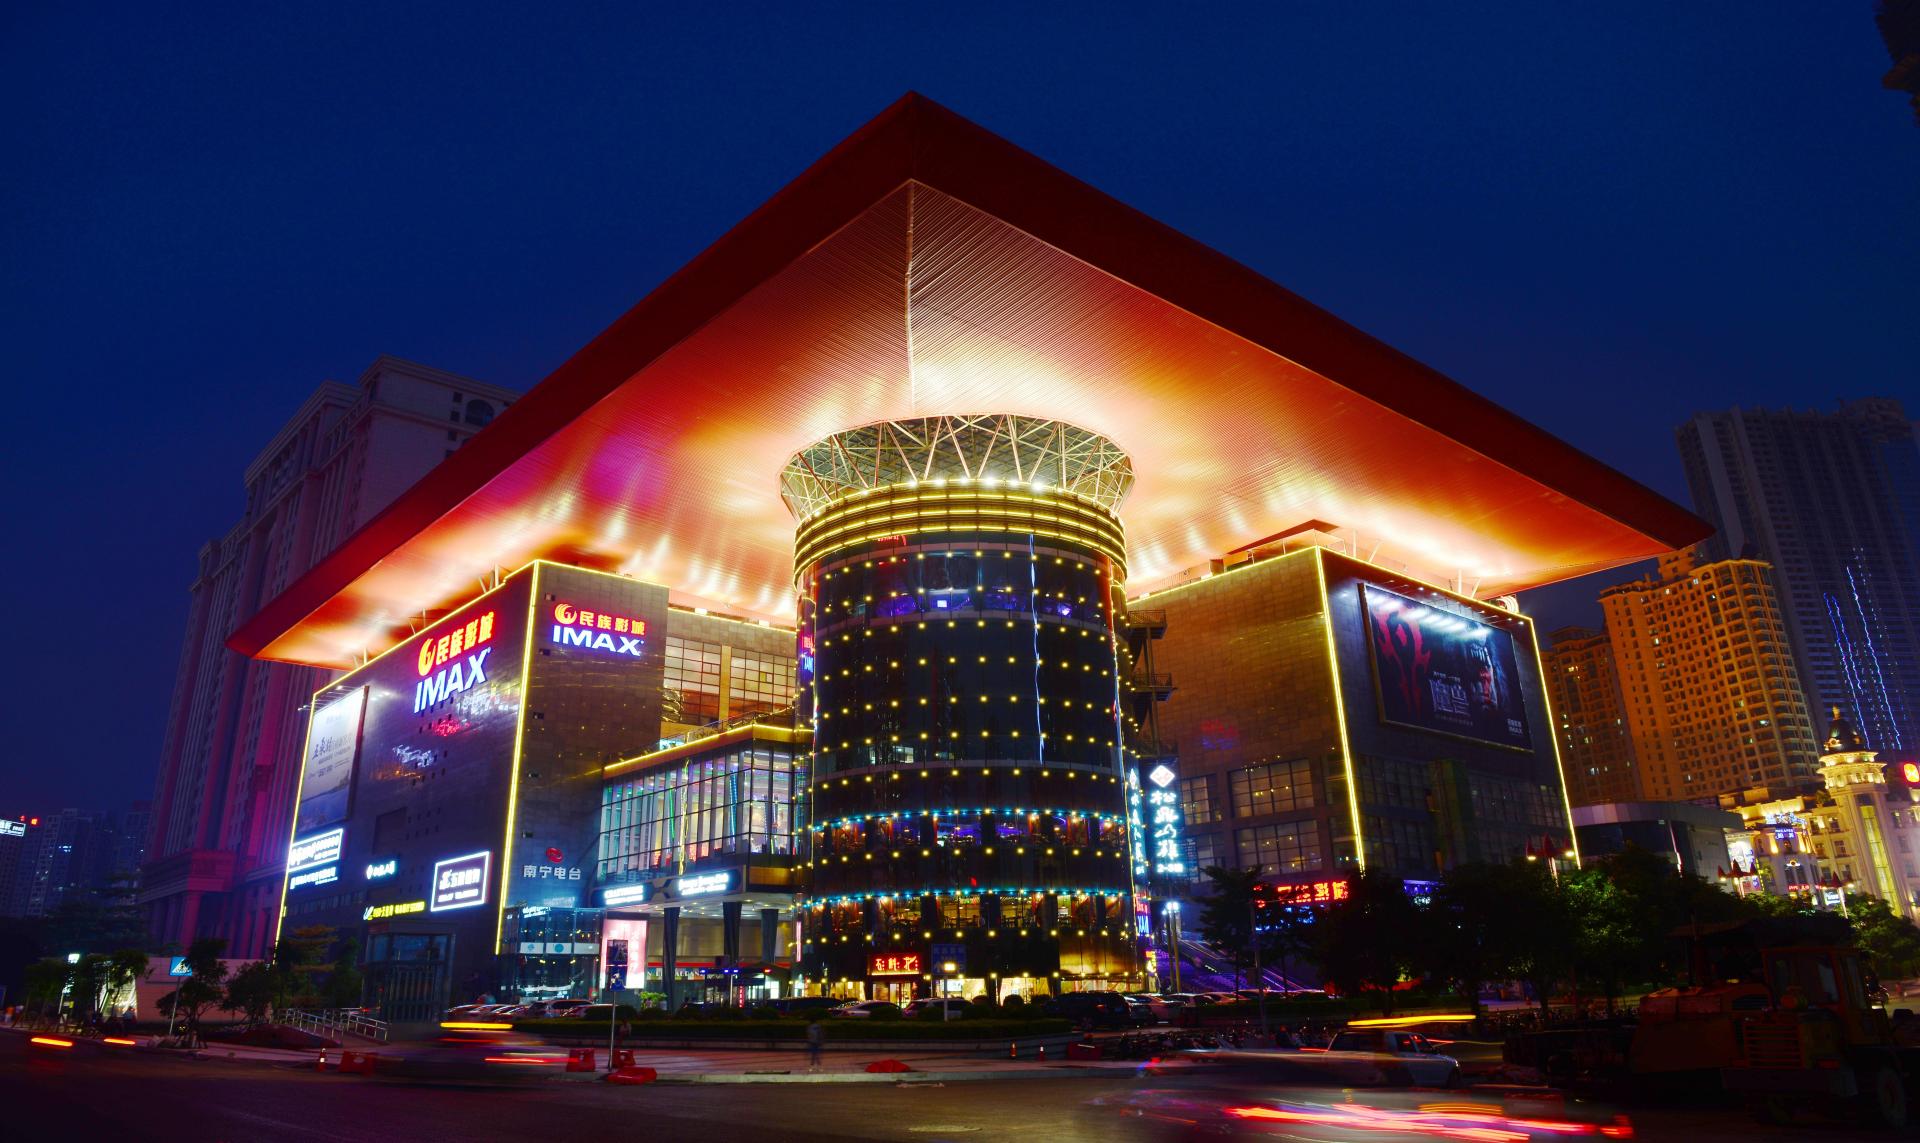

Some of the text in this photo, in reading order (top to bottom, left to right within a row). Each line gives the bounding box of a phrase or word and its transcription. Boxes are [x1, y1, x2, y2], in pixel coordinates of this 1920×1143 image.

[436, 611, 495, 665] 民族影城
[579, 610, 646, 636] 民族影城
[552, 625, 641, 656] IMAX
[414, 650, 488, 713] IMAX
[523, 864, 582, 880] 南宁电台
